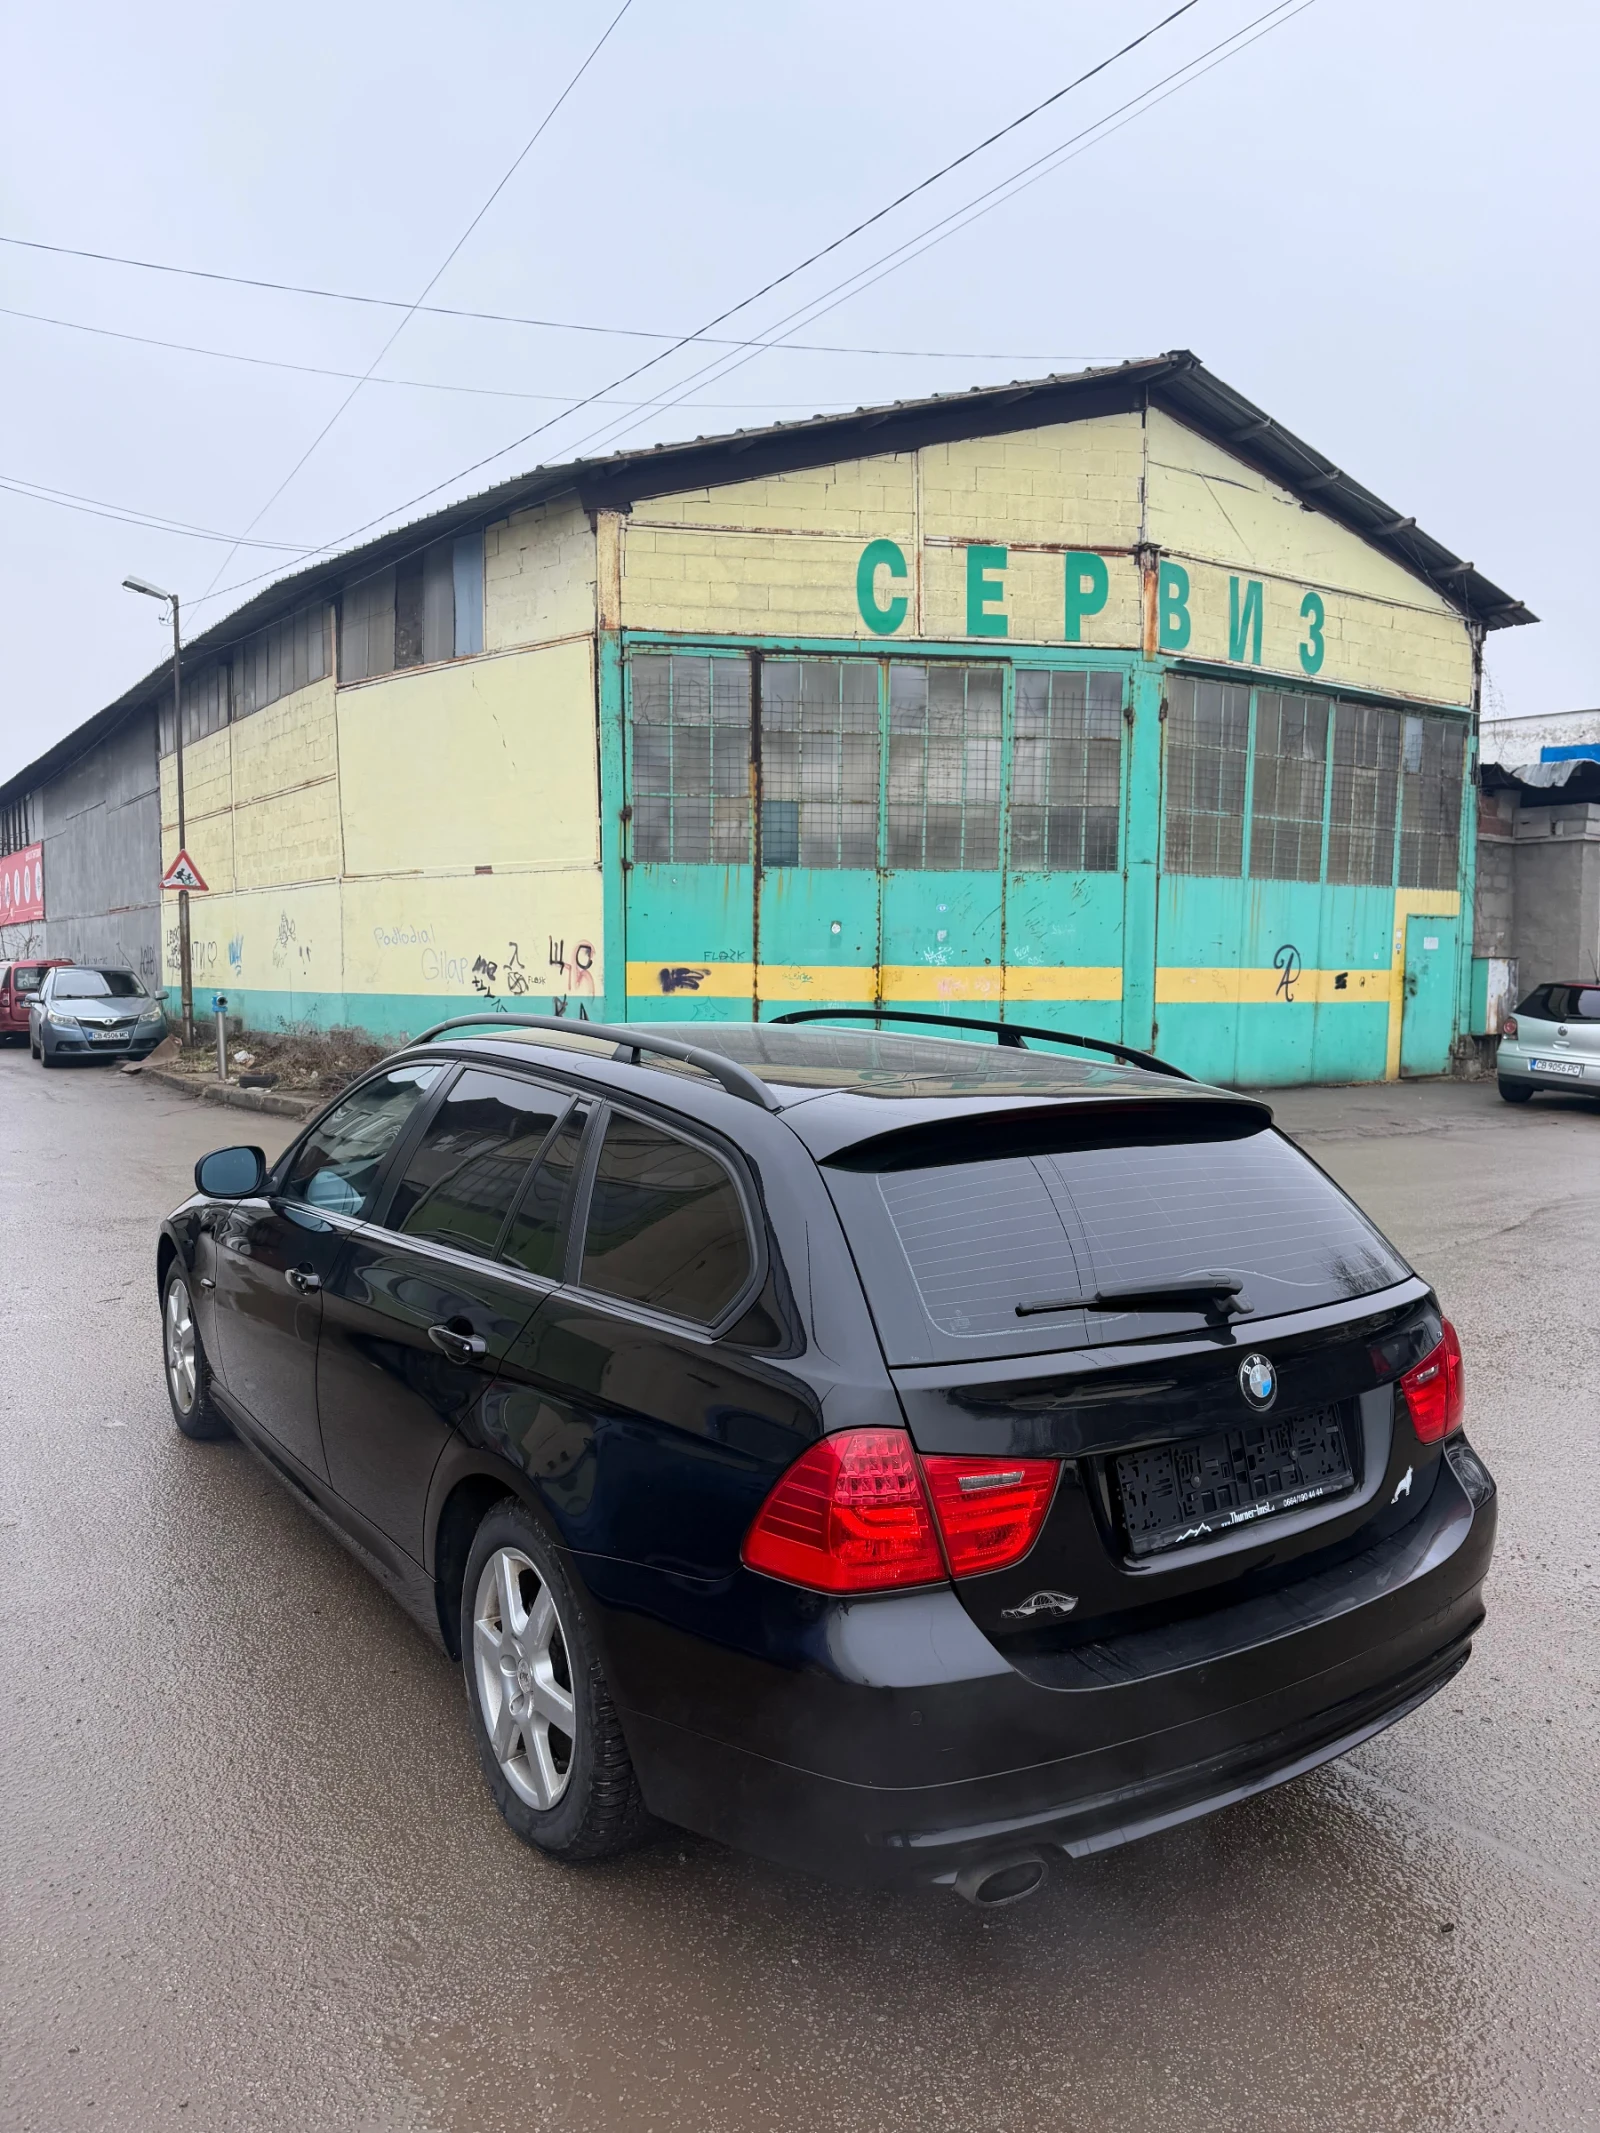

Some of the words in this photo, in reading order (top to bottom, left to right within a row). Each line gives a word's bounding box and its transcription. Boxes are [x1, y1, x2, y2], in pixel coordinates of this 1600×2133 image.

[856, 538, 1325, 675] СЕРВИЗ
[1536, 1060, 1547, 1070] CB
[1548, 1062, 1567, 1072] 9056
[1567, 1065, 1579, 1074] PC
